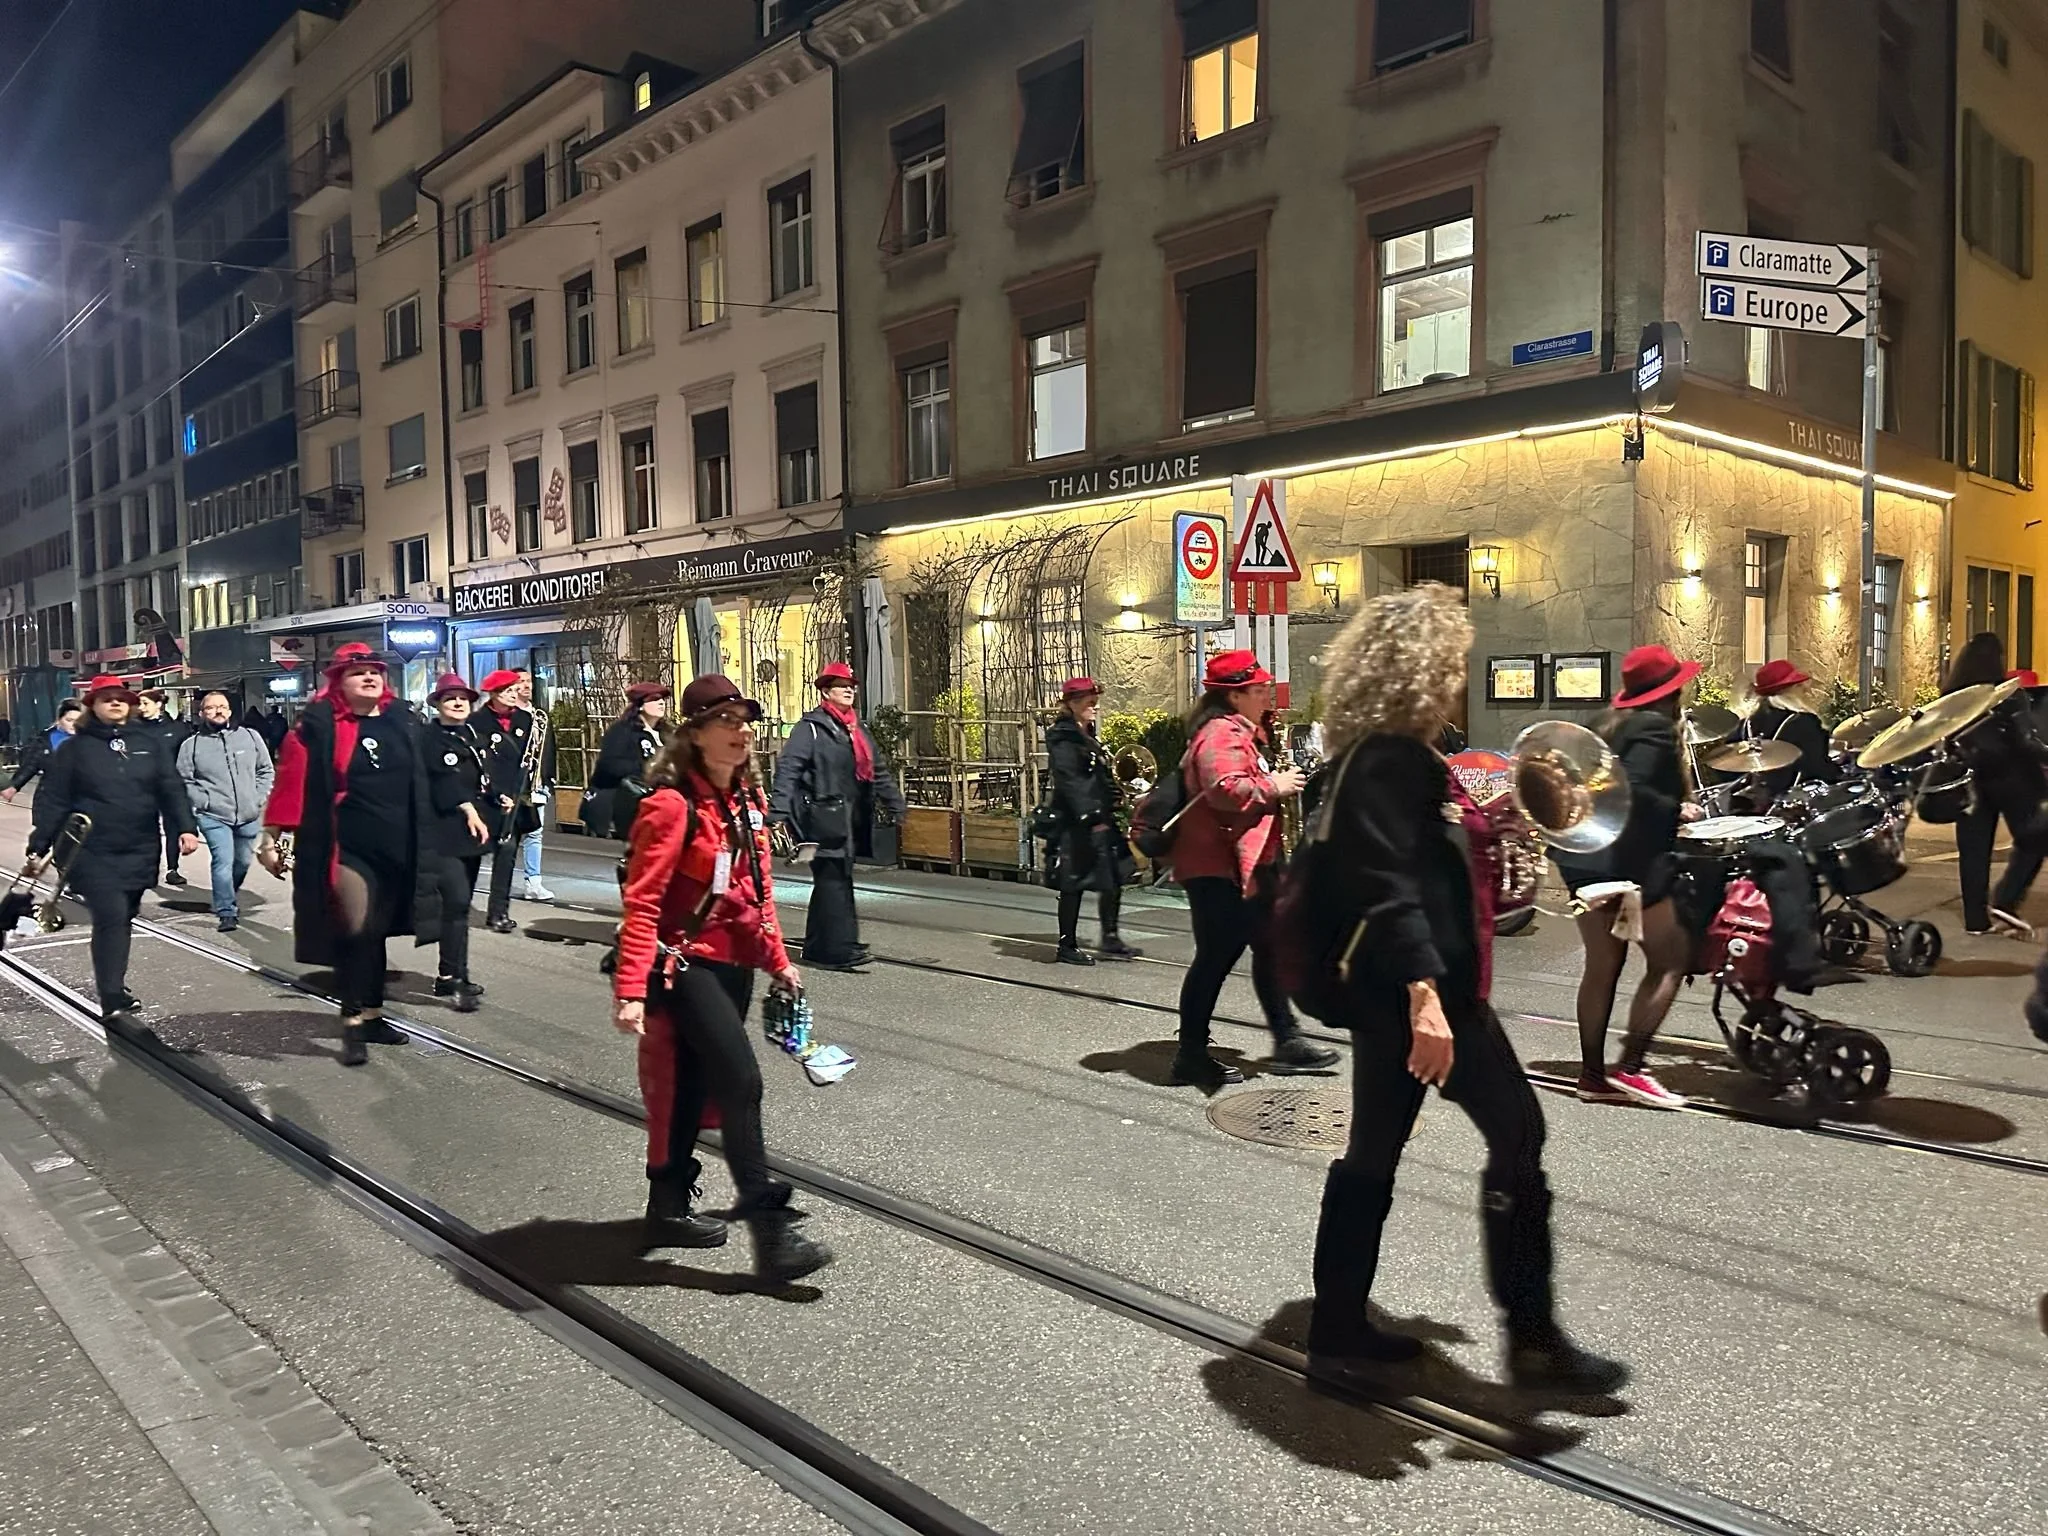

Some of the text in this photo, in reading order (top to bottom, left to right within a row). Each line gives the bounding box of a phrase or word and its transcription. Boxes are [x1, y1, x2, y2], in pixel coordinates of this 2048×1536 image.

[1739, 244, 1832, 275] Claramatte
[1746, 290, 1828, 328] Europe
[1527, 337, 1577, 353] Clarastrasse
[1642, 344, 1659, 365] THAI
[1638, 355, 1663, 382] SQUARE
[1788, 421, 1862, 462] THAI SQUA
[1049, 455, 1200, 499] THAI SQUARE
[677, 549, 814, 582] Reimann Graveure
[455, 570, 605, 612] BÄCKEREI KONDITOREI
[1450, 764, 1487, 778] Hungry
[1460, 774, 1487, 791] uple
